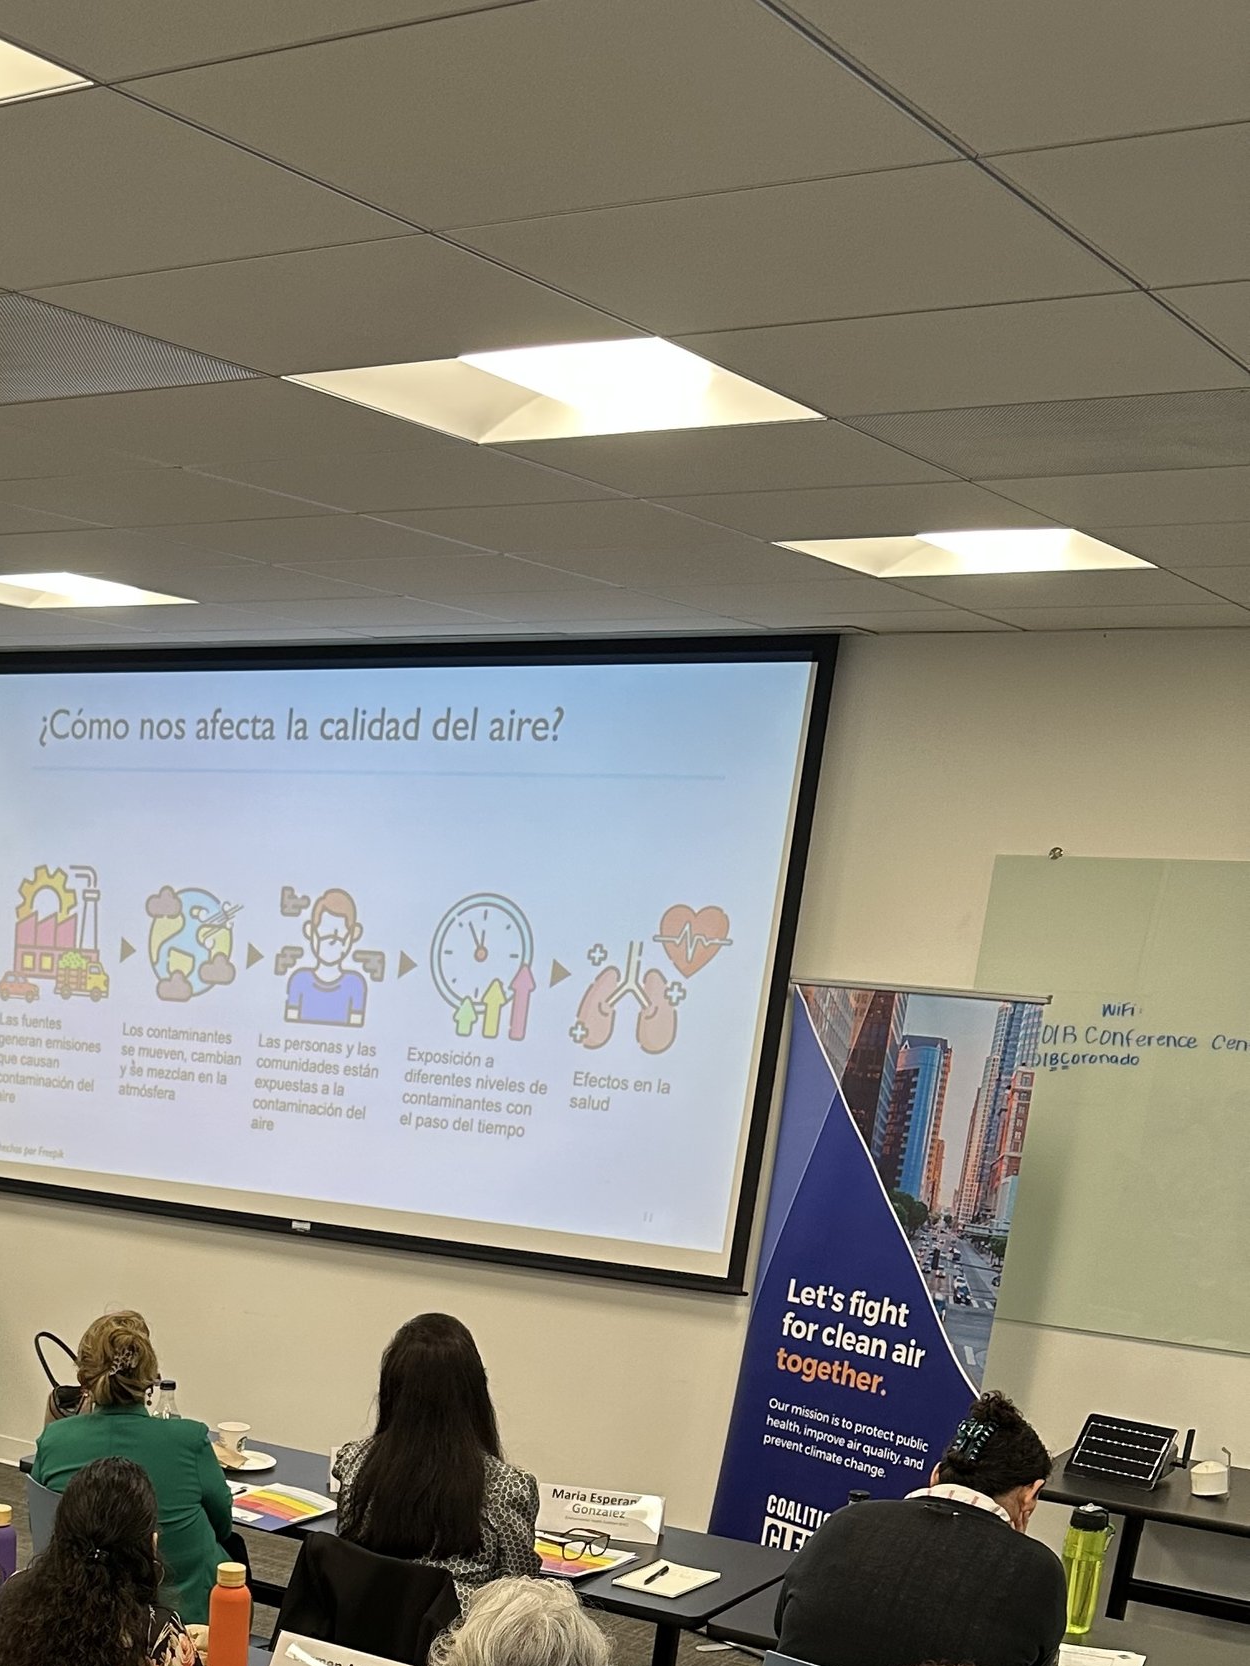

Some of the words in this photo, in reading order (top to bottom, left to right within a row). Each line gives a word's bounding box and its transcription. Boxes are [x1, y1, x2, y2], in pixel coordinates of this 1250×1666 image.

[39, 708, 130, 747] ¿Cómo
[139, 717, 186, 740] nos
[195, 708, 275, 740] afecta
[286, 707, 309, 740] la
[320, 707, 421, 741] calidad
[432, 707, 478, 741] del
[489, 706, 565, 742] aire?
[0, 1012, 19, 1027] Las
[22, 1013, 62, 1030] fuentes
[45, 1035, 101, 1053] emisiones
[122, 1022, 144, 1038] Los
[146, 1026, 233, 1045] contaminantes
[1085, 1026, 1198, 1049] Conference
[121, 1044, 135, 1056] se
[138, 1046, 187, 1063] mueven,
[191, 1051, 242, 1067] cambian
[258, 1033, 281, 1049] Las
[284, 1038, 343, 1054] personas
[345, 1043, 354, 1059] y
[357, 1041, 377, 1057] las
[407, 1046, 481, 1067] Exposición
[485, 1056, 495, 1068] a
[20, 1054, 60, 1069] causan
[256, 1056, 340, 1075] comunidades
[343, 1063, 379, 1079] están
[1034, 1052, 1140, 1070] 1BCoronado
[77, 1078, 95, 1092] del
[119, 1064, 127, 1079] y
[146, 1067, 195, 1082] mezclan
[198, 1071, 213, 1084] en
[216, 1071, 227, 1085] la
[404, 1069, 472, 1089] diferentes
[475, 1075, 526, 1093] niveles
[529, 1079, 548, 1096] de
[572, 1071, 629, 1091] Efectos
[633, 1079, 652, 1093] en
[656, 1078, 671, 1095] la
[118, 1083, 176, 1101] atmósfera
[254, 1077, 318, 1094] expuestas
[321, 1083, 330, 1095] a
[333, 1082, 345, 1097] la
[252, 1098, 343, 1118] contaminación
[346, 1105, 366, 1120] del
[402, 1092, 503, 1113] contaminantes
[506, 1103, 533, 1116] con
[569, 1094, 611, 1112] salud
[250, 1116, 275, 1131] aire
[400, 1112, 412, 1126] el
[415, 1115, 449, 1131] paso
[452, 1117, 474, 1132] del
[477, 1119, 526, 1140] tiempo
[787, 1278, 846, 1313] Let's
[849, 1289, 910, 1328] fight
[781, 1311, 819, 1342] for
[821, 1322, 888, 1360] clean
[891, 1338, 927, 1369] air
[776, 1347, 887, 1397] together.
[768, 1397, 790, 1412] Our
[790, 1403, 830, 1425] mission
[831, 1413, 841, 1427] is
[841, 1417, 853, 1430] to
[853, 1422, 894, 1442] protect
[895, 1433, 929, 1453] public
[766, 1414, 802, 1435] health,
[803, 1424, 846, 1447] improve
[846, 1438, 861, 1451] air
[862, 1443, 902, 1465] quality,
[903, 1455, 925, 1471] and
[763, 1433, 803, 1453] prevent
[804, 1444, 843, 1465] climate
[843, 1457, 886, 1479] change.
[552, 1488, 587, 1502] Maria
[590, 1493, 638, 1506] Esperan
[572, 1503, 626, 1519] Gonzalez
[766, 1494, 832, 1529] COALITI
